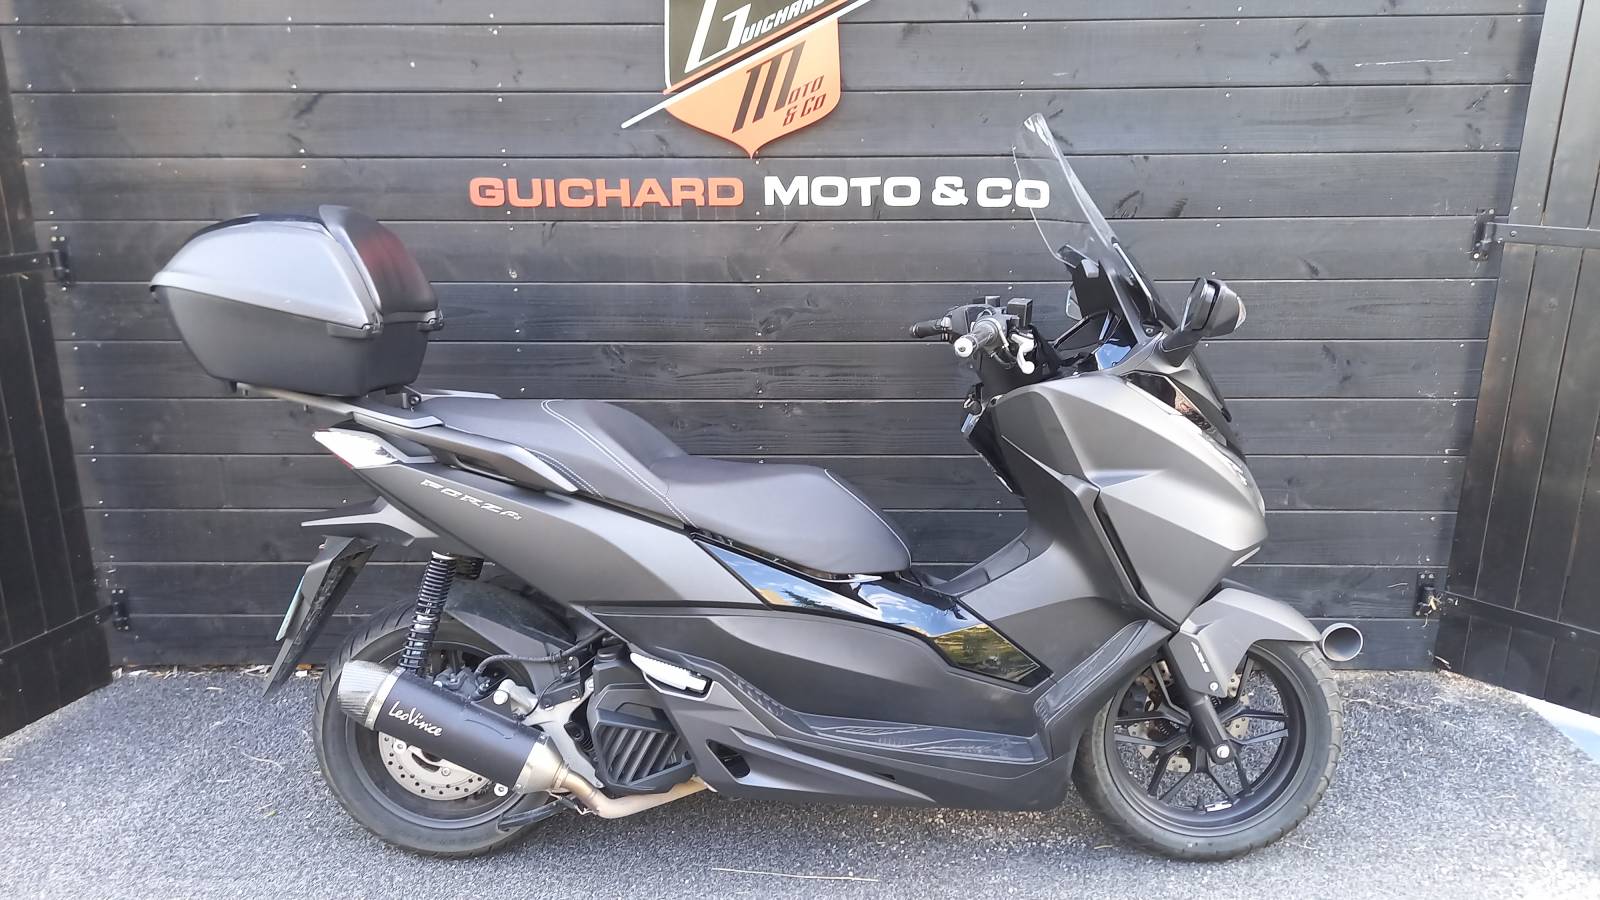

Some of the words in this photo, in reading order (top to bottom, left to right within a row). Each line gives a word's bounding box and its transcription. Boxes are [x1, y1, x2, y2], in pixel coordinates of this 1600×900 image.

[782, 105, 798, 127] &
[469, 177, 744, 207] GUICHARD
[764, 176, 921, 207] MOTO
[931, 176, 969, 206] &
[976, 177, 1050, 208] CO
[420, 479, 522, 520] FORZA
[388, 700, 443, 737] LeoVince
